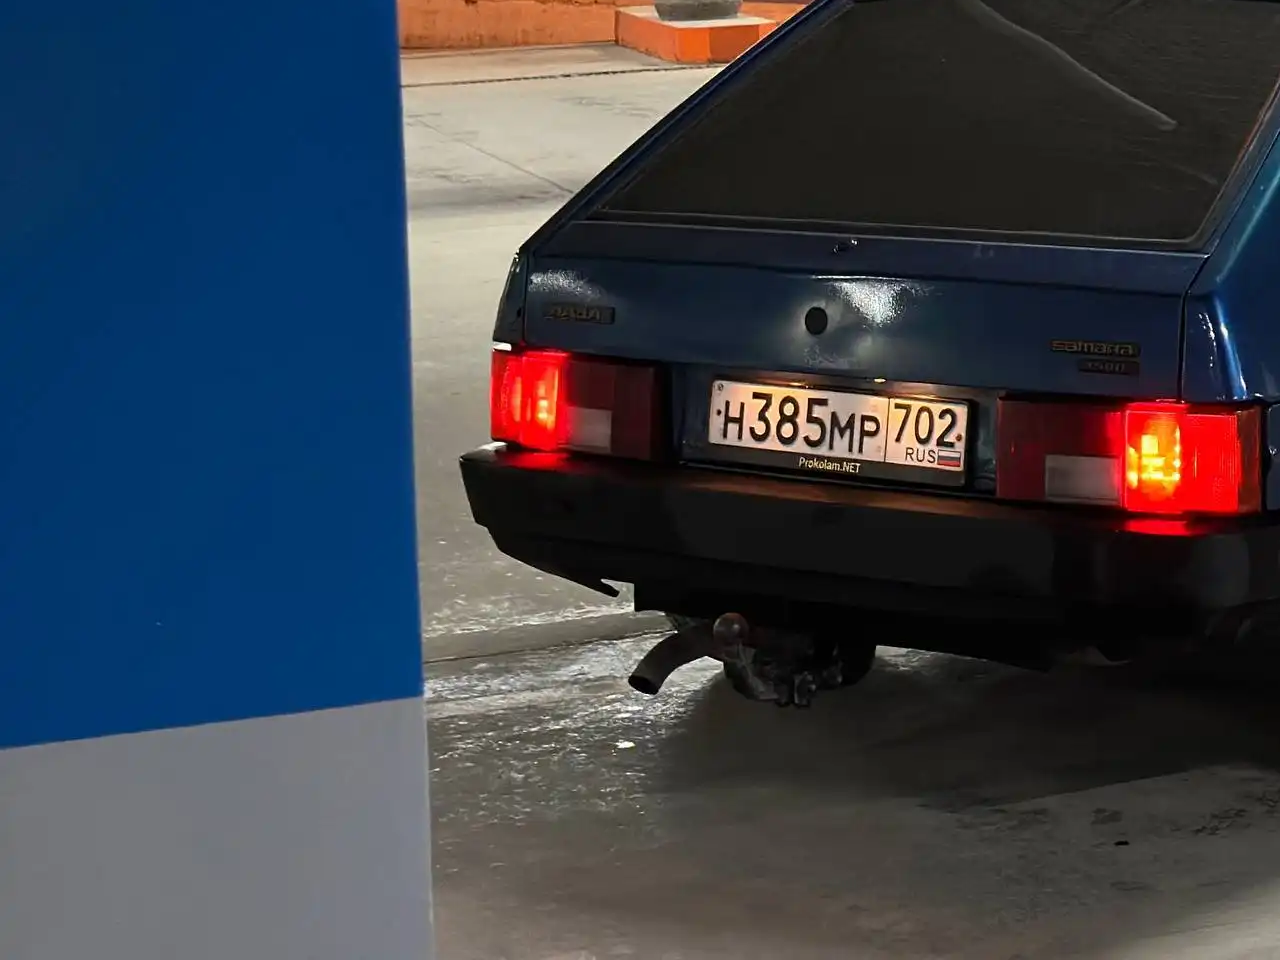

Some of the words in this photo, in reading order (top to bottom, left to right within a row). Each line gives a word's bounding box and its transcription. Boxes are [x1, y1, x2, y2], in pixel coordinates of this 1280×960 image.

[894, 402, 957, 448] 702
[904, 447, 936, 464] RUS
[798, 456, 861, 474] Prokolam.NET
